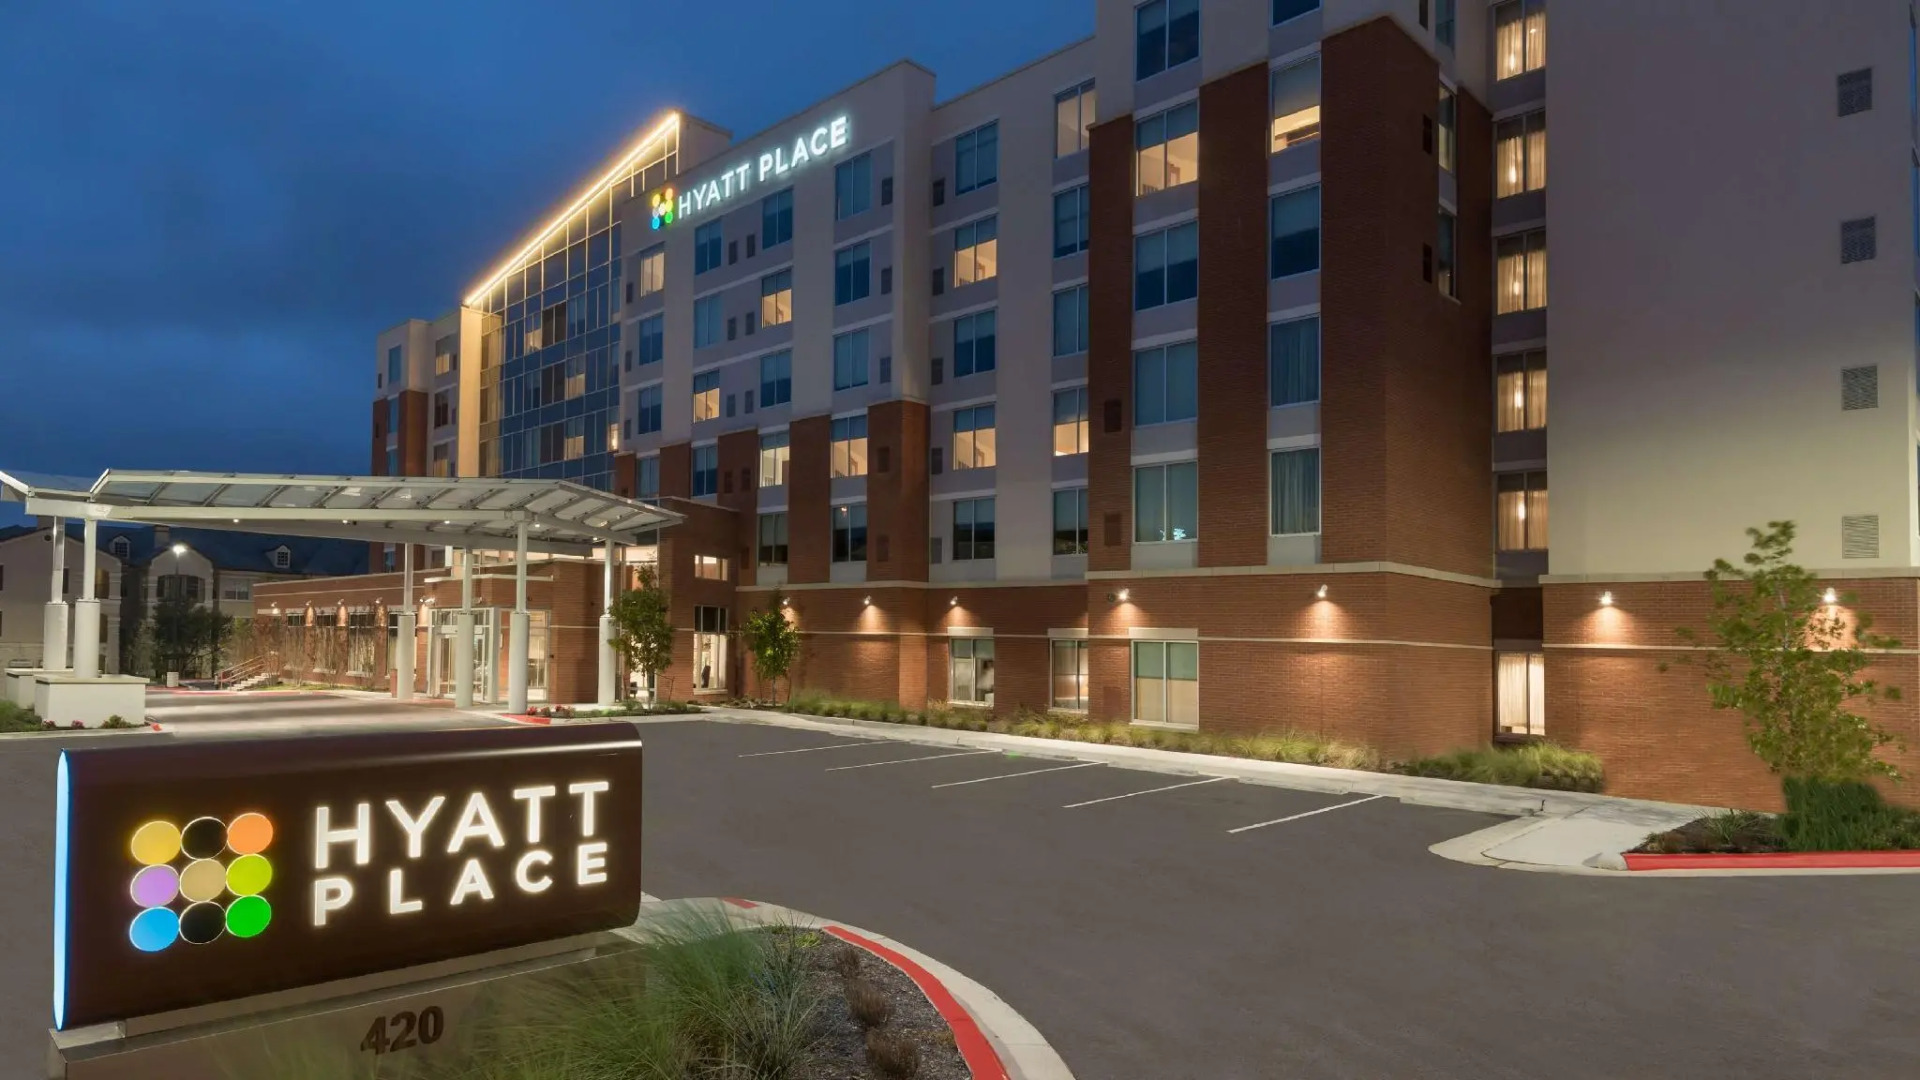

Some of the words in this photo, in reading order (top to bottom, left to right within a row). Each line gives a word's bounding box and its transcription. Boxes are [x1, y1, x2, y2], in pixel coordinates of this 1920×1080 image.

[678, 162, 749, 219] HYATT
[759, 116, 848, 182] PLACE
[314, 781, 610, 869] HYATT
[313, 842, 609, 927] PLACE
[360, 1005, 444, 1055] 420
